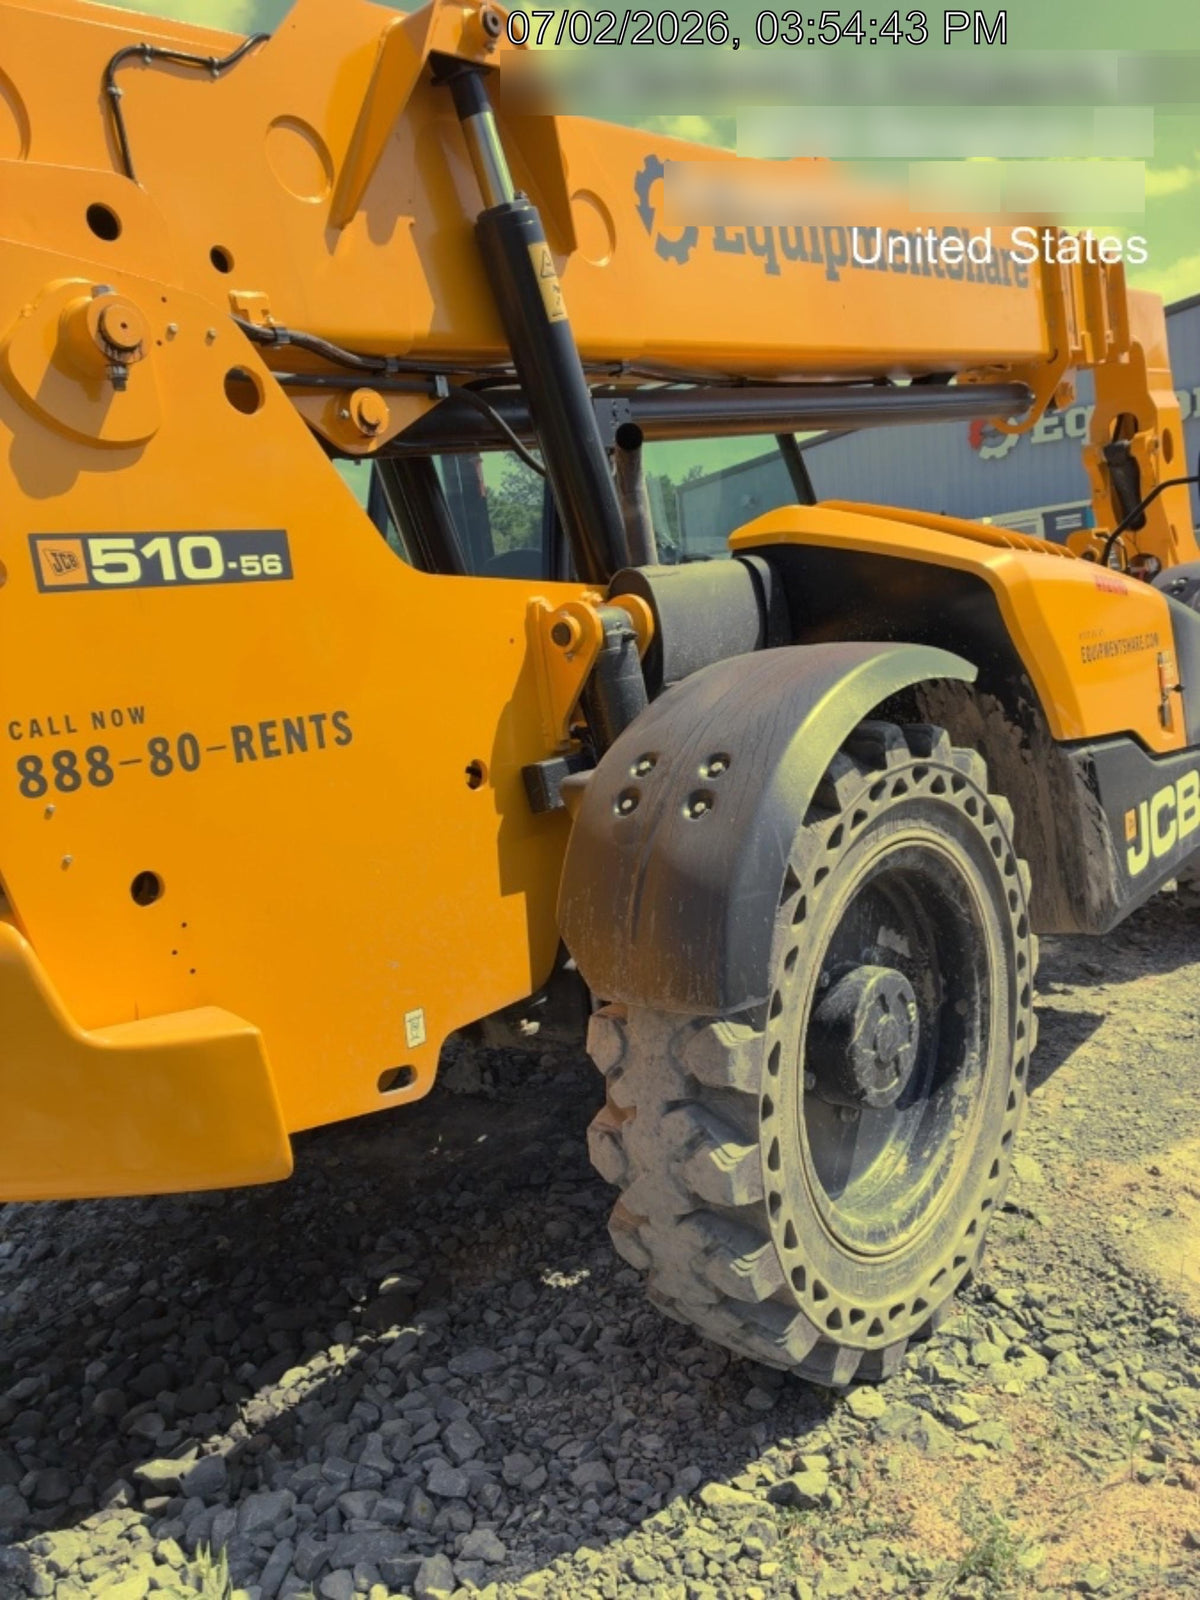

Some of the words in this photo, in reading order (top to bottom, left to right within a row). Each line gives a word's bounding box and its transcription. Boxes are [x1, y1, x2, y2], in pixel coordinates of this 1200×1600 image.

[87, 535, 284, 584] 510-56
[8, 714, 78, 741] CALL
[91, 705, 146, 731] NOW
[16, 709, 354, 799] 888-80-RENTS
[1126, 769, 1200, 877] JCB
